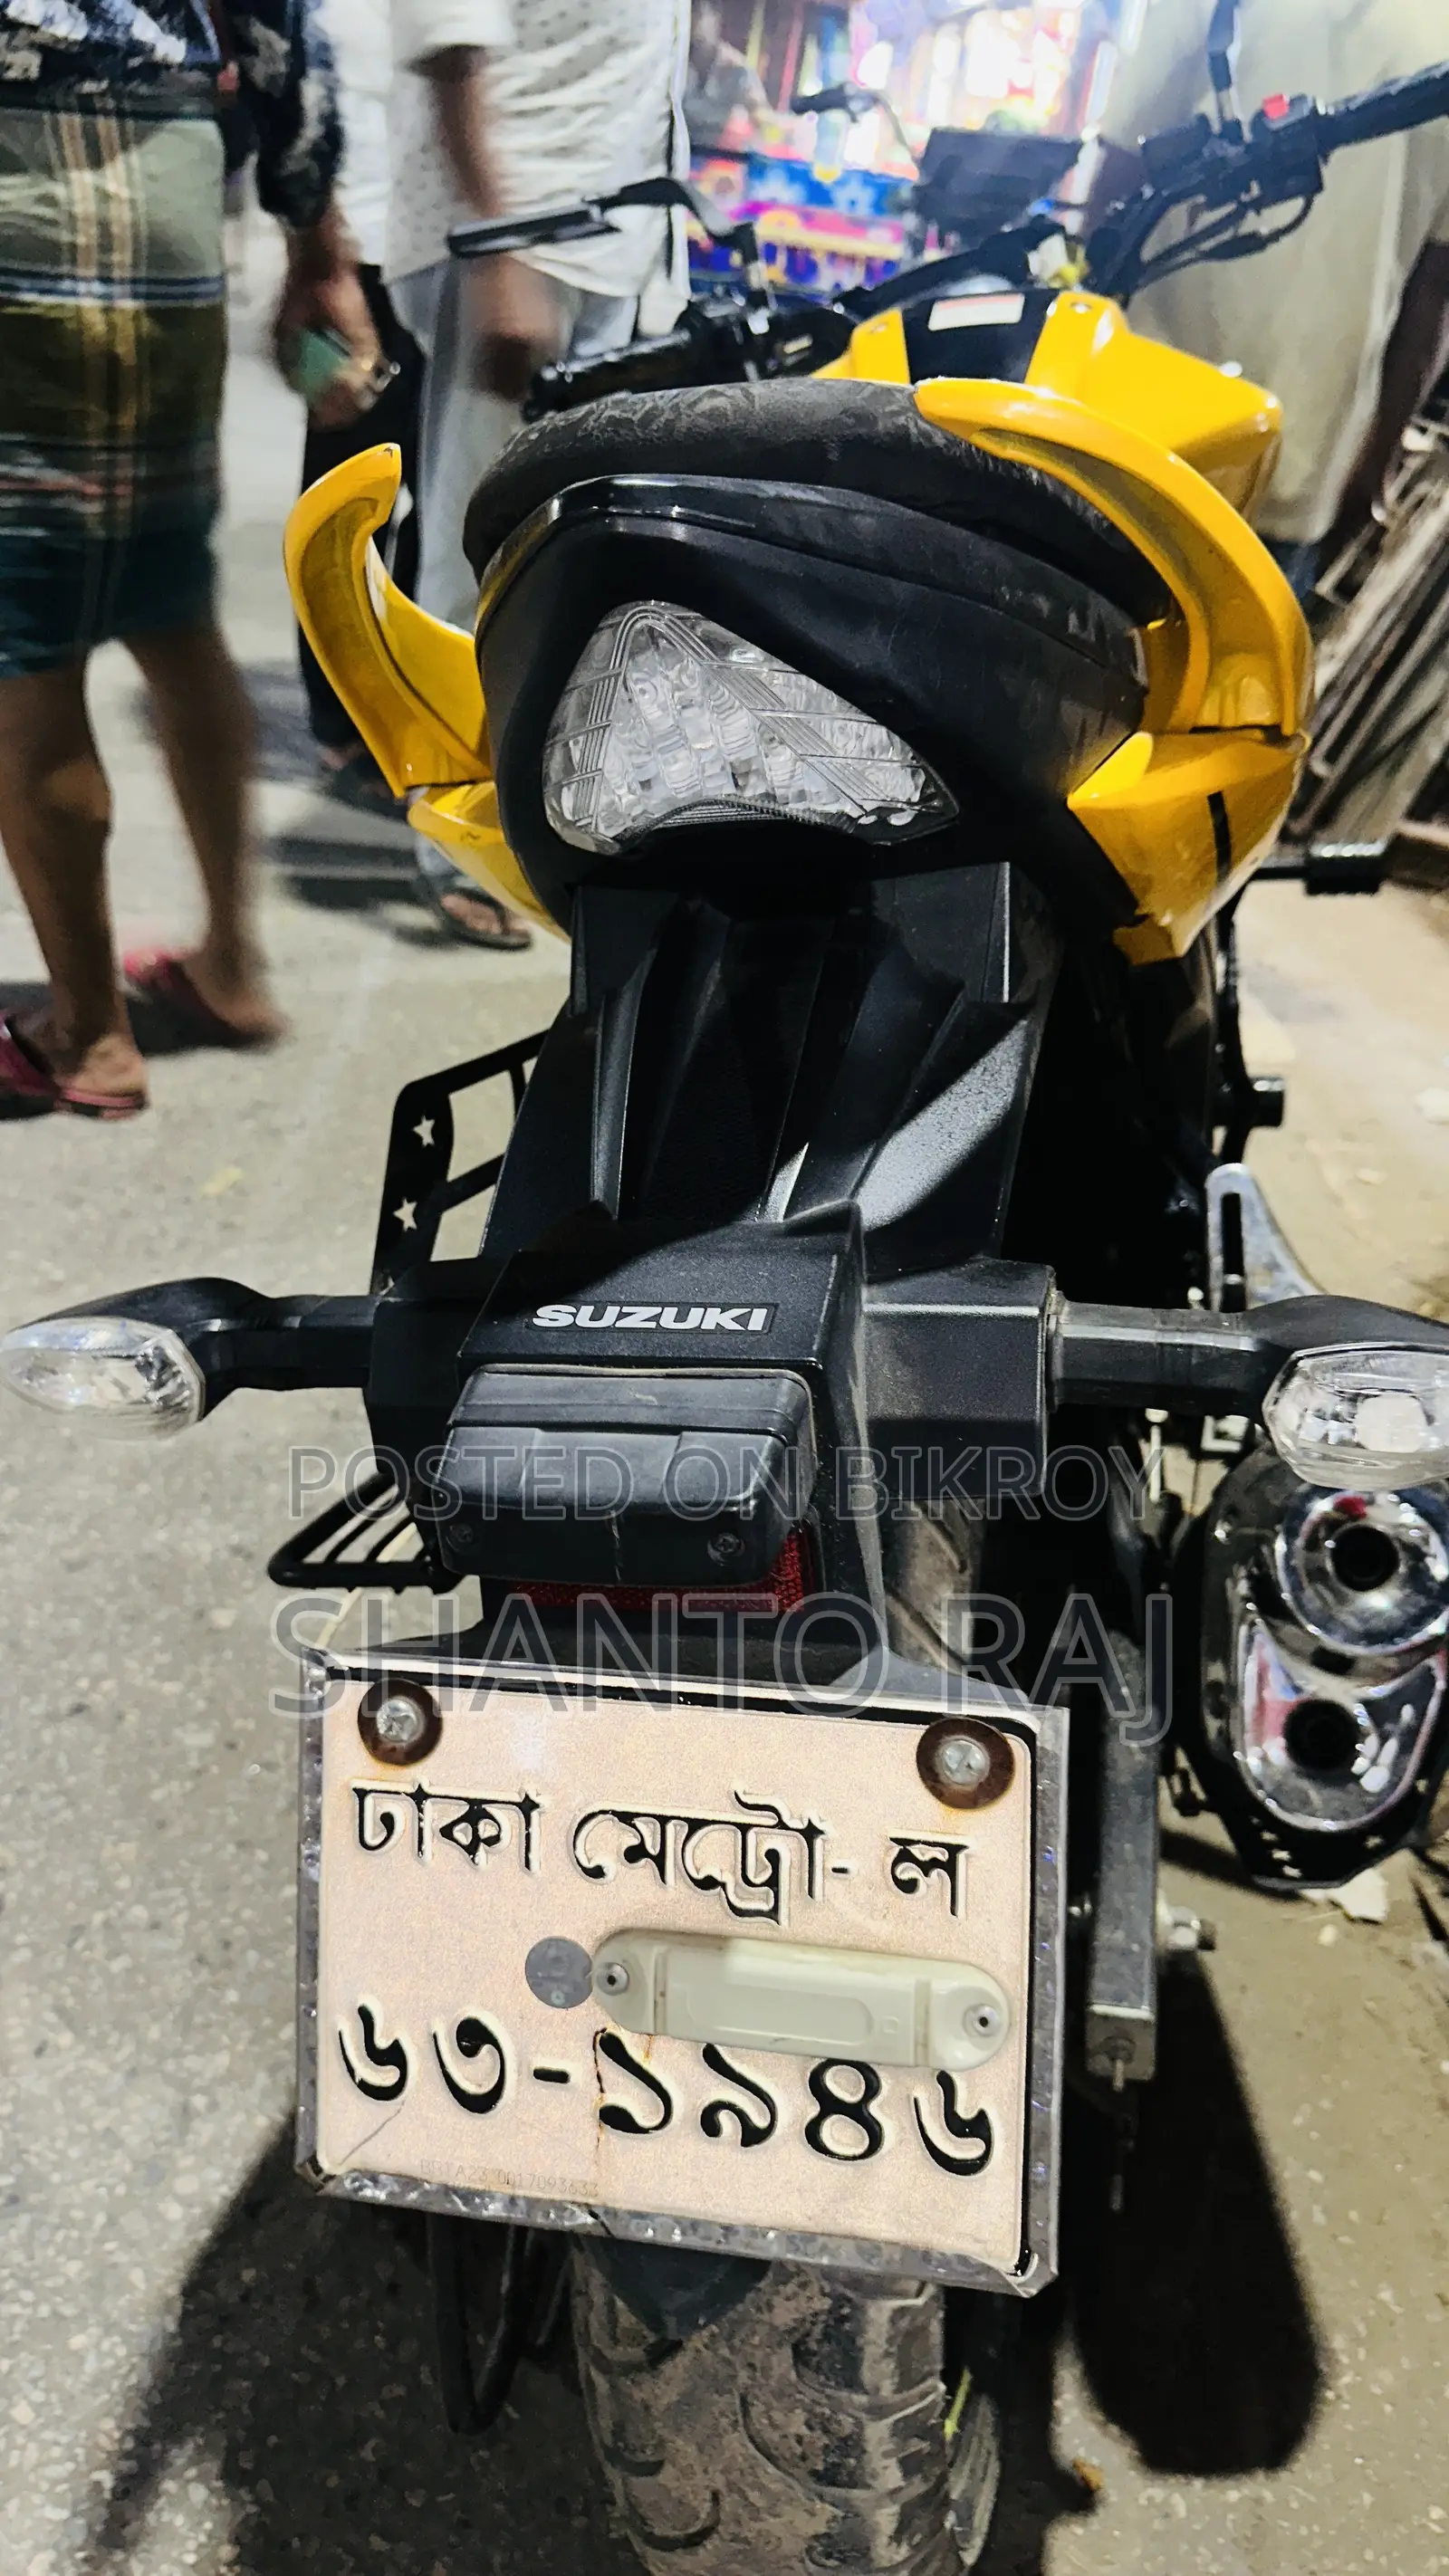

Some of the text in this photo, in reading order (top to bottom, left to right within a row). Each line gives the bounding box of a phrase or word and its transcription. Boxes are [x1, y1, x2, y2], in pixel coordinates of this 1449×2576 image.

[533, 1304, 768, 1331] SUZUKI
[351, 1782, 543, 1872] ঢাকা
[888, 1834, 971, 1917] ল
[339, 2002, 998, 2177] ৬৩-১৯৪৬
